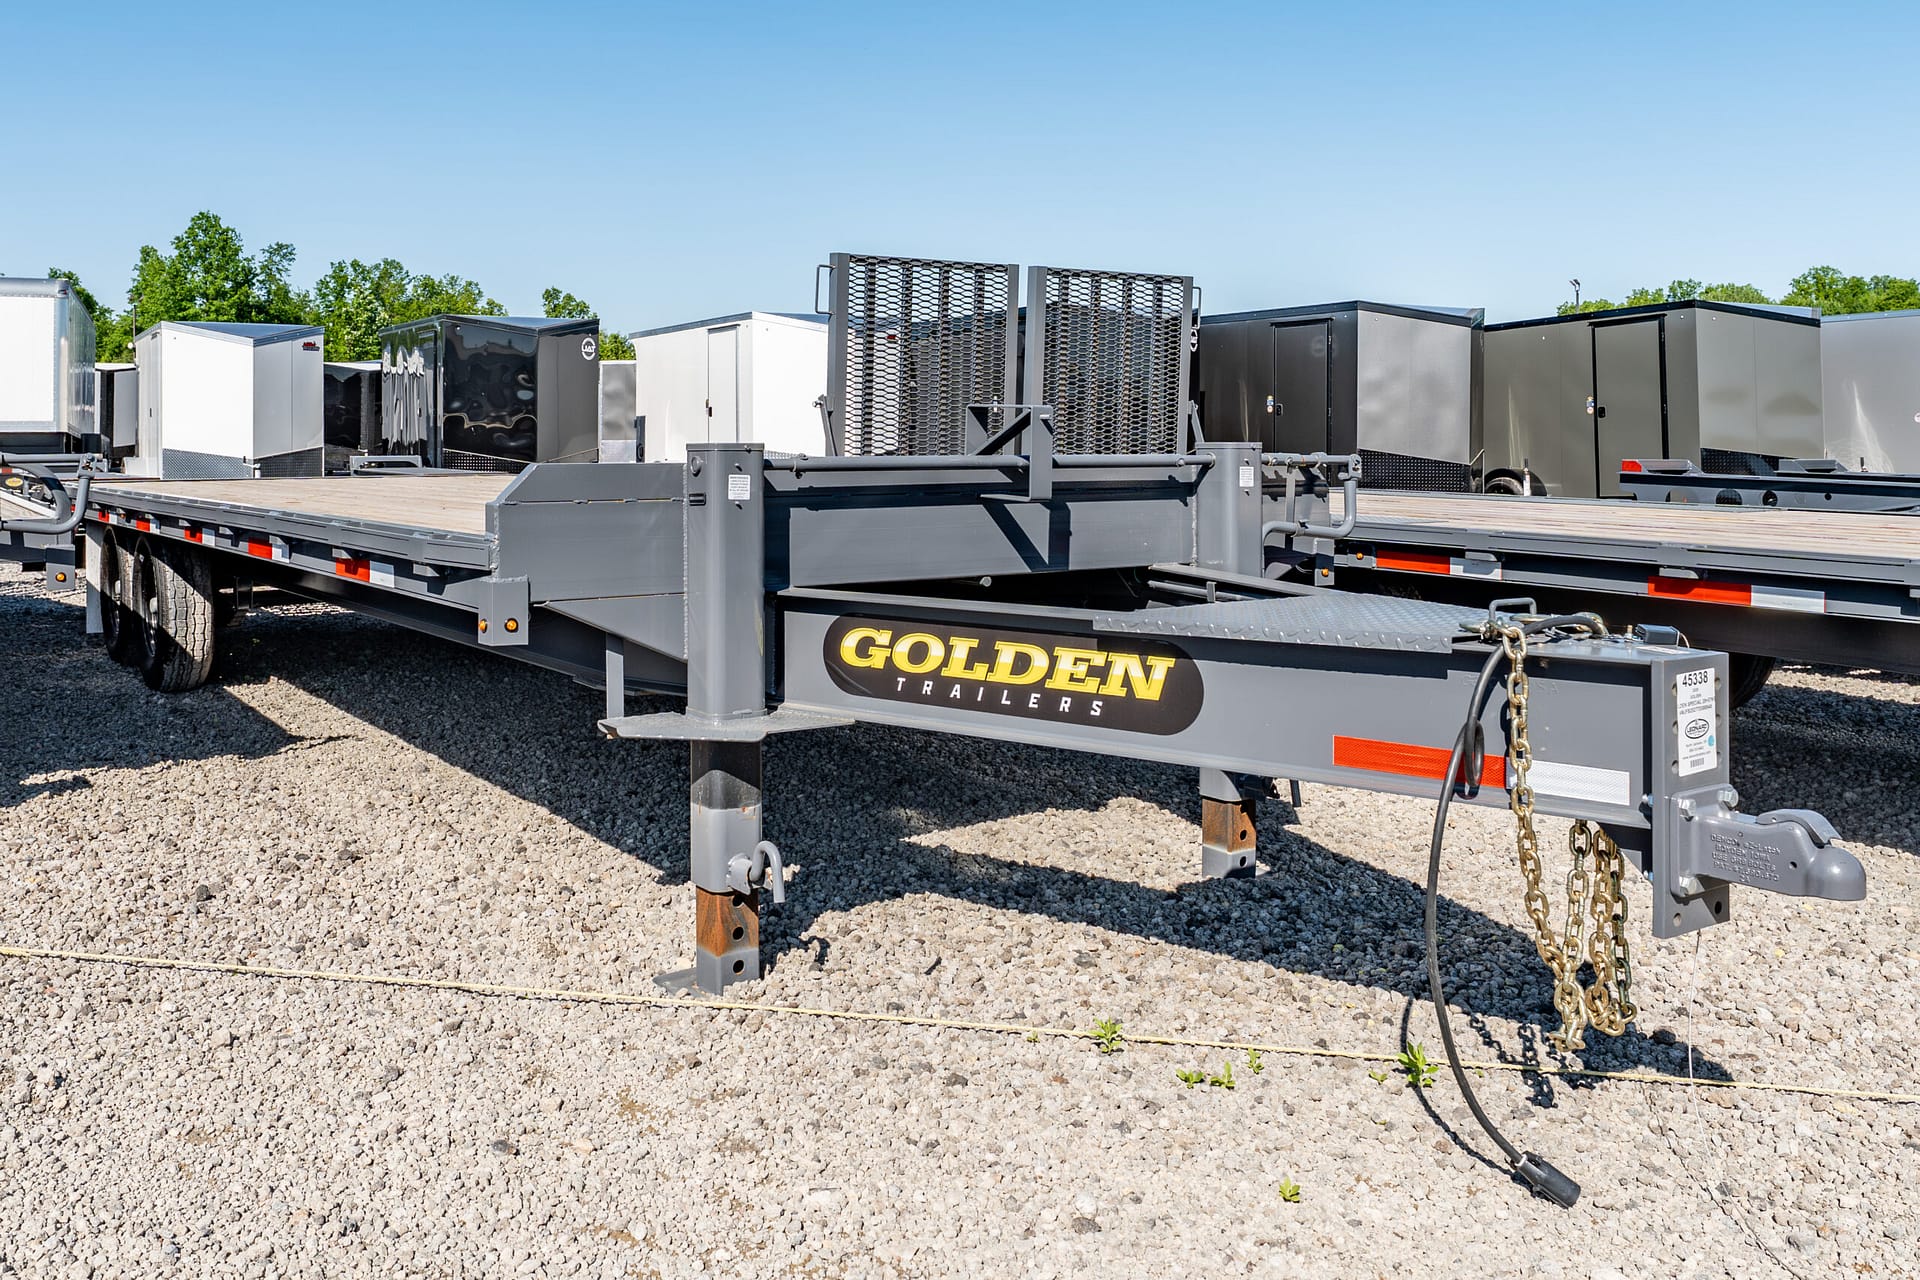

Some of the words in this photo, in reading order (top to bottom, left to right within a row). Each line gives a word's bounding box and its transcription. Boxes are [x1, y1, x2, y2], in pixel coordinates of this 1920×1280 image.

[839, 627, 1175, 702] GOLDEN
[1682, 670, 1708, 687] 45338
[896, 677, 1103, 717] TRAILERS
